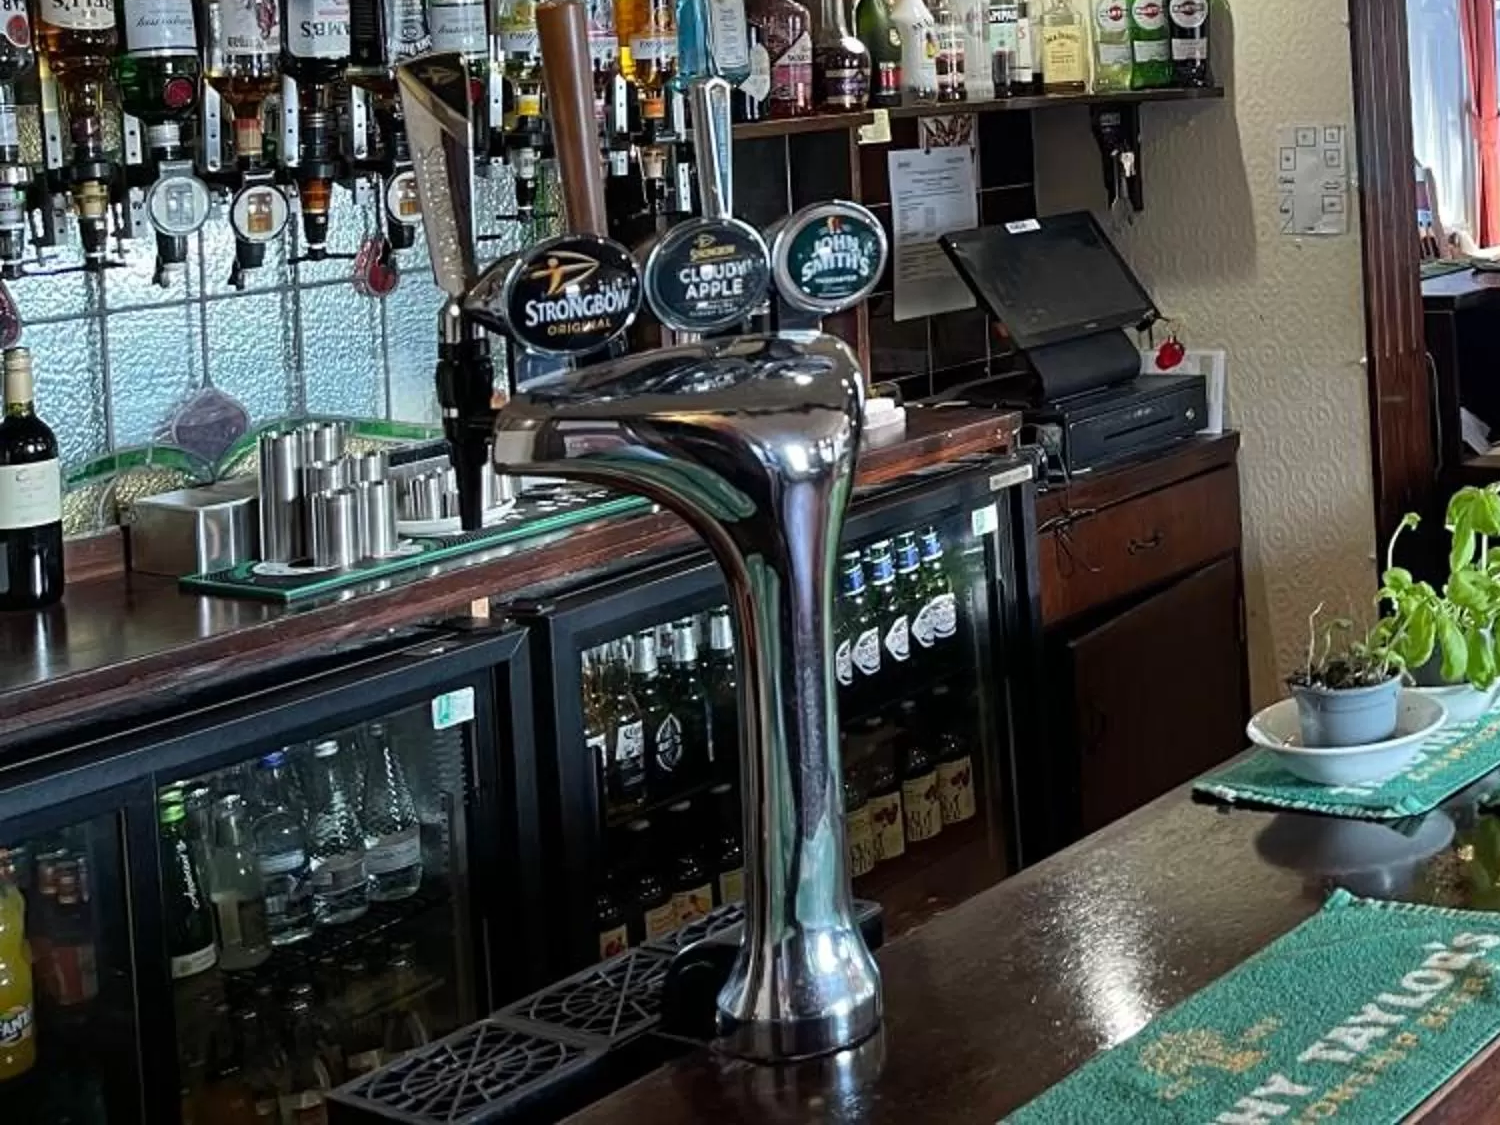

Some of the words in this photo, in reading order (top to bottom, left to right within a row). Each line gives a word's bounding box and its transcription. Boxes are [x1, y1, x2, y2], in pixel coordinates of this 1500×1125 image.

[300, 20, 351, 39] AMB'S
[811, 234, 859, 258] JOHN
[801, 248, 871, 283] SMITH'S
[685, 278, 743, 300] APPLE
[524, 285, 632, 327] STRONGBOW
[547, 317, 612, 337] ORIGINAL
